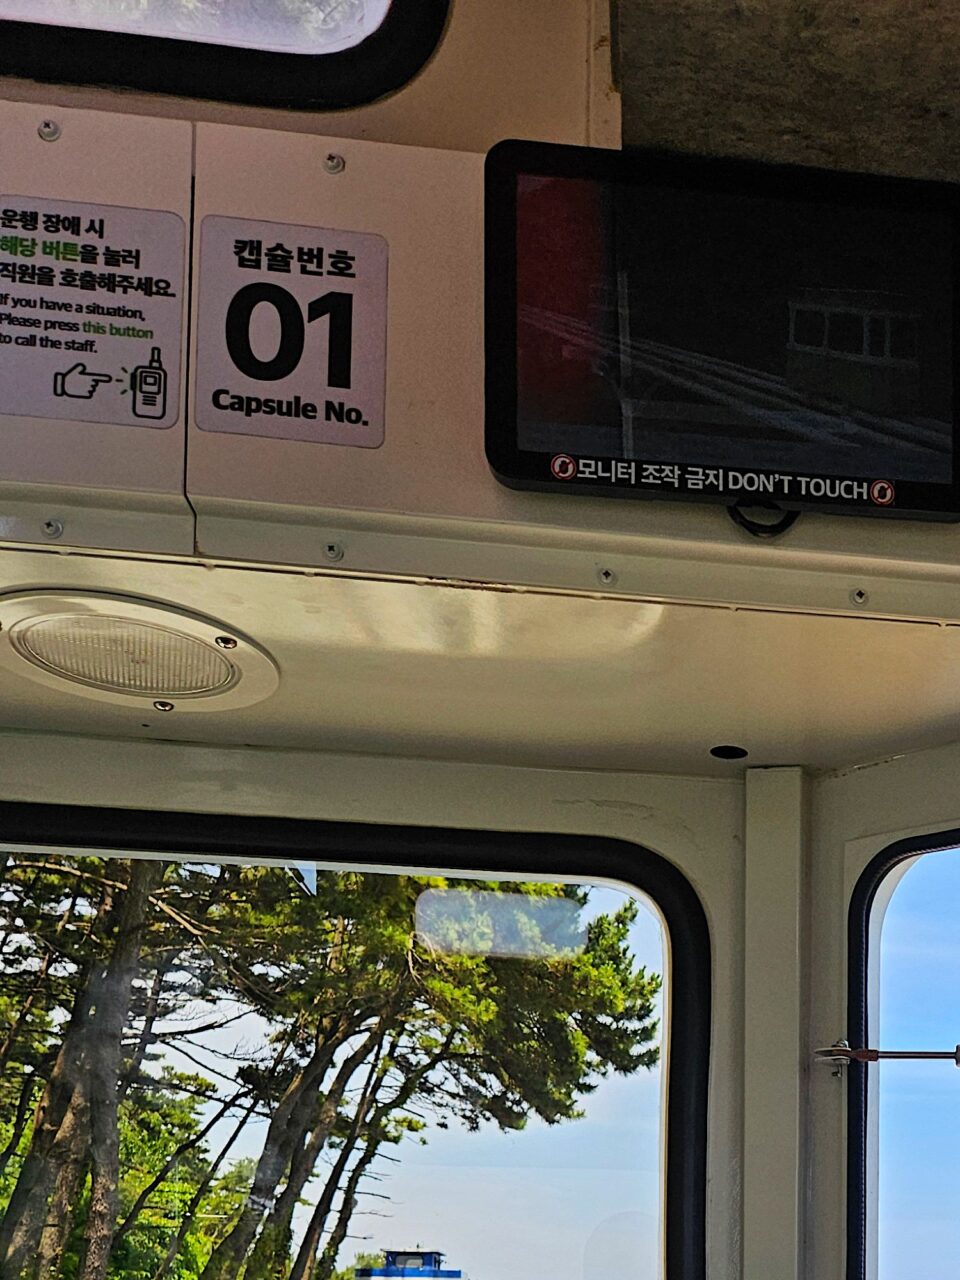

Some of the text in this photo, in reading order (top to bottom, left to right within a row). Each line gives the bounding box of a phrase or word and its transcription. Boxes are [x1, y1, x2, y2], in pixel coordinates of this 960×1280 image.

[0, 208, 105, 239] 운행 장애 시
[0, 235, 141, 269] 해당 버튼을 눌러
[233, 238, 357, 279] 캡슐번호
[0, 262, 56, 286] 직원을
[11, 297, 37, 309] you
[40, 297, 73, 312] have
[75, 304, 83, 313] a
[85, 302, 146, 321] situation,
[0, 312, 154, 339] Please press this button
[225, 281, 354, 390] 01
[14, 334, 36, 347] call
[39, 335, 62, 349] the
[64, 340, 98, 353] staff.
[211, 388, 370, 427] Capsule No.
[577, 458, 868, 500] 모니터 조작 금지 DON'T TOUCH
